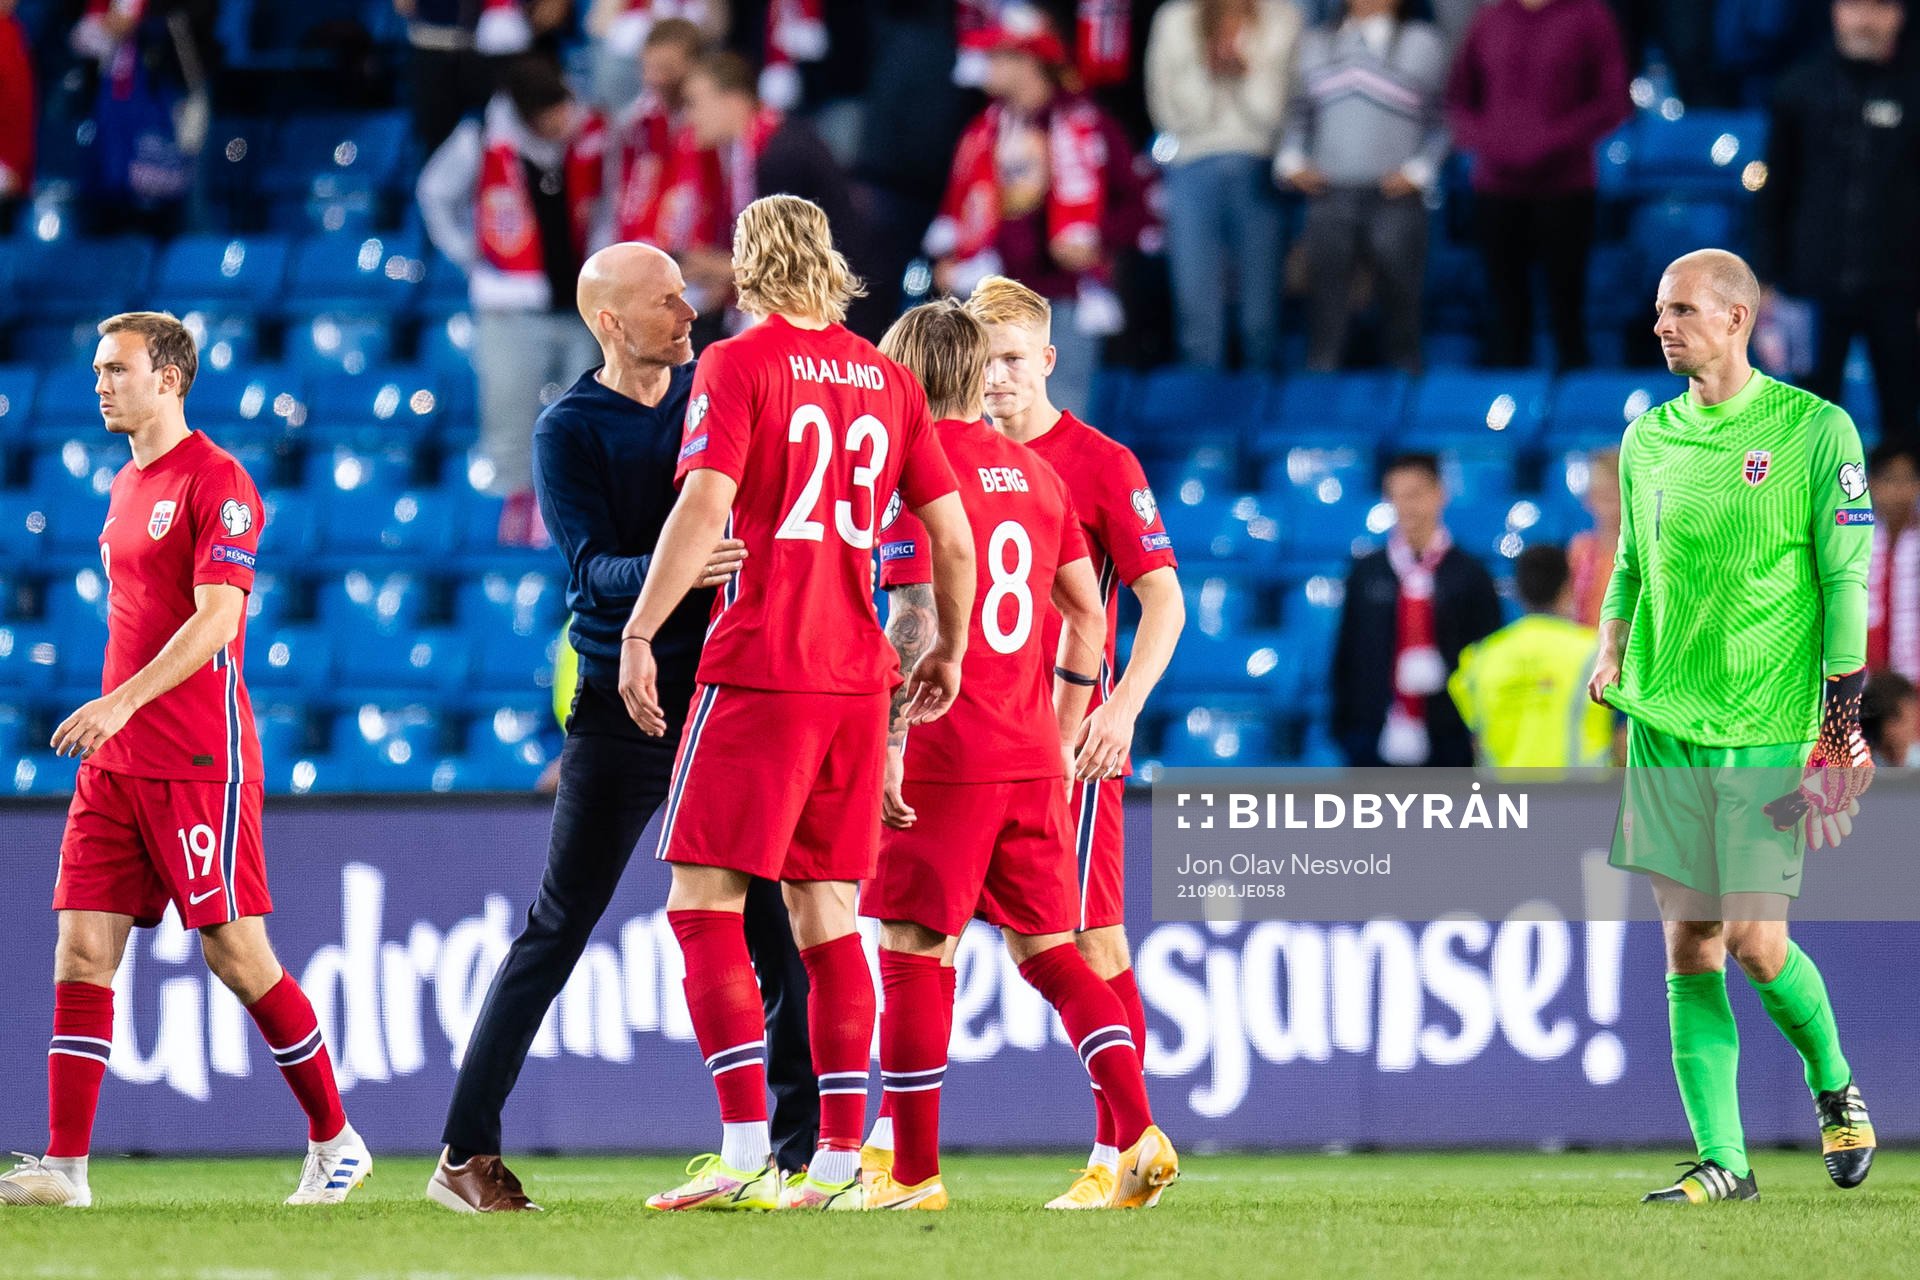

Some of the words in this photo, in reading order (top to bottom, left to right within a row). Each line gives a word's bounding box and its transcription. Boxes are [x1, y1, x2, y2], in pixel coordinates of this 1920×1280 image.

[789, 355, 884, 391] HAALAND
[775, 404, 889, 549] 23
[978, 468, 1029, 493] BERG
[1655, 490, 1664, 541] 1
[1848, 513, 1874, 522] RESPE
[226, 549, 256, 566] RESPECT
[981, 520, 1034, 654] 8
[177, 823, 216, 880] 19
[1135, 848, 1626, 1118] sjanse!
